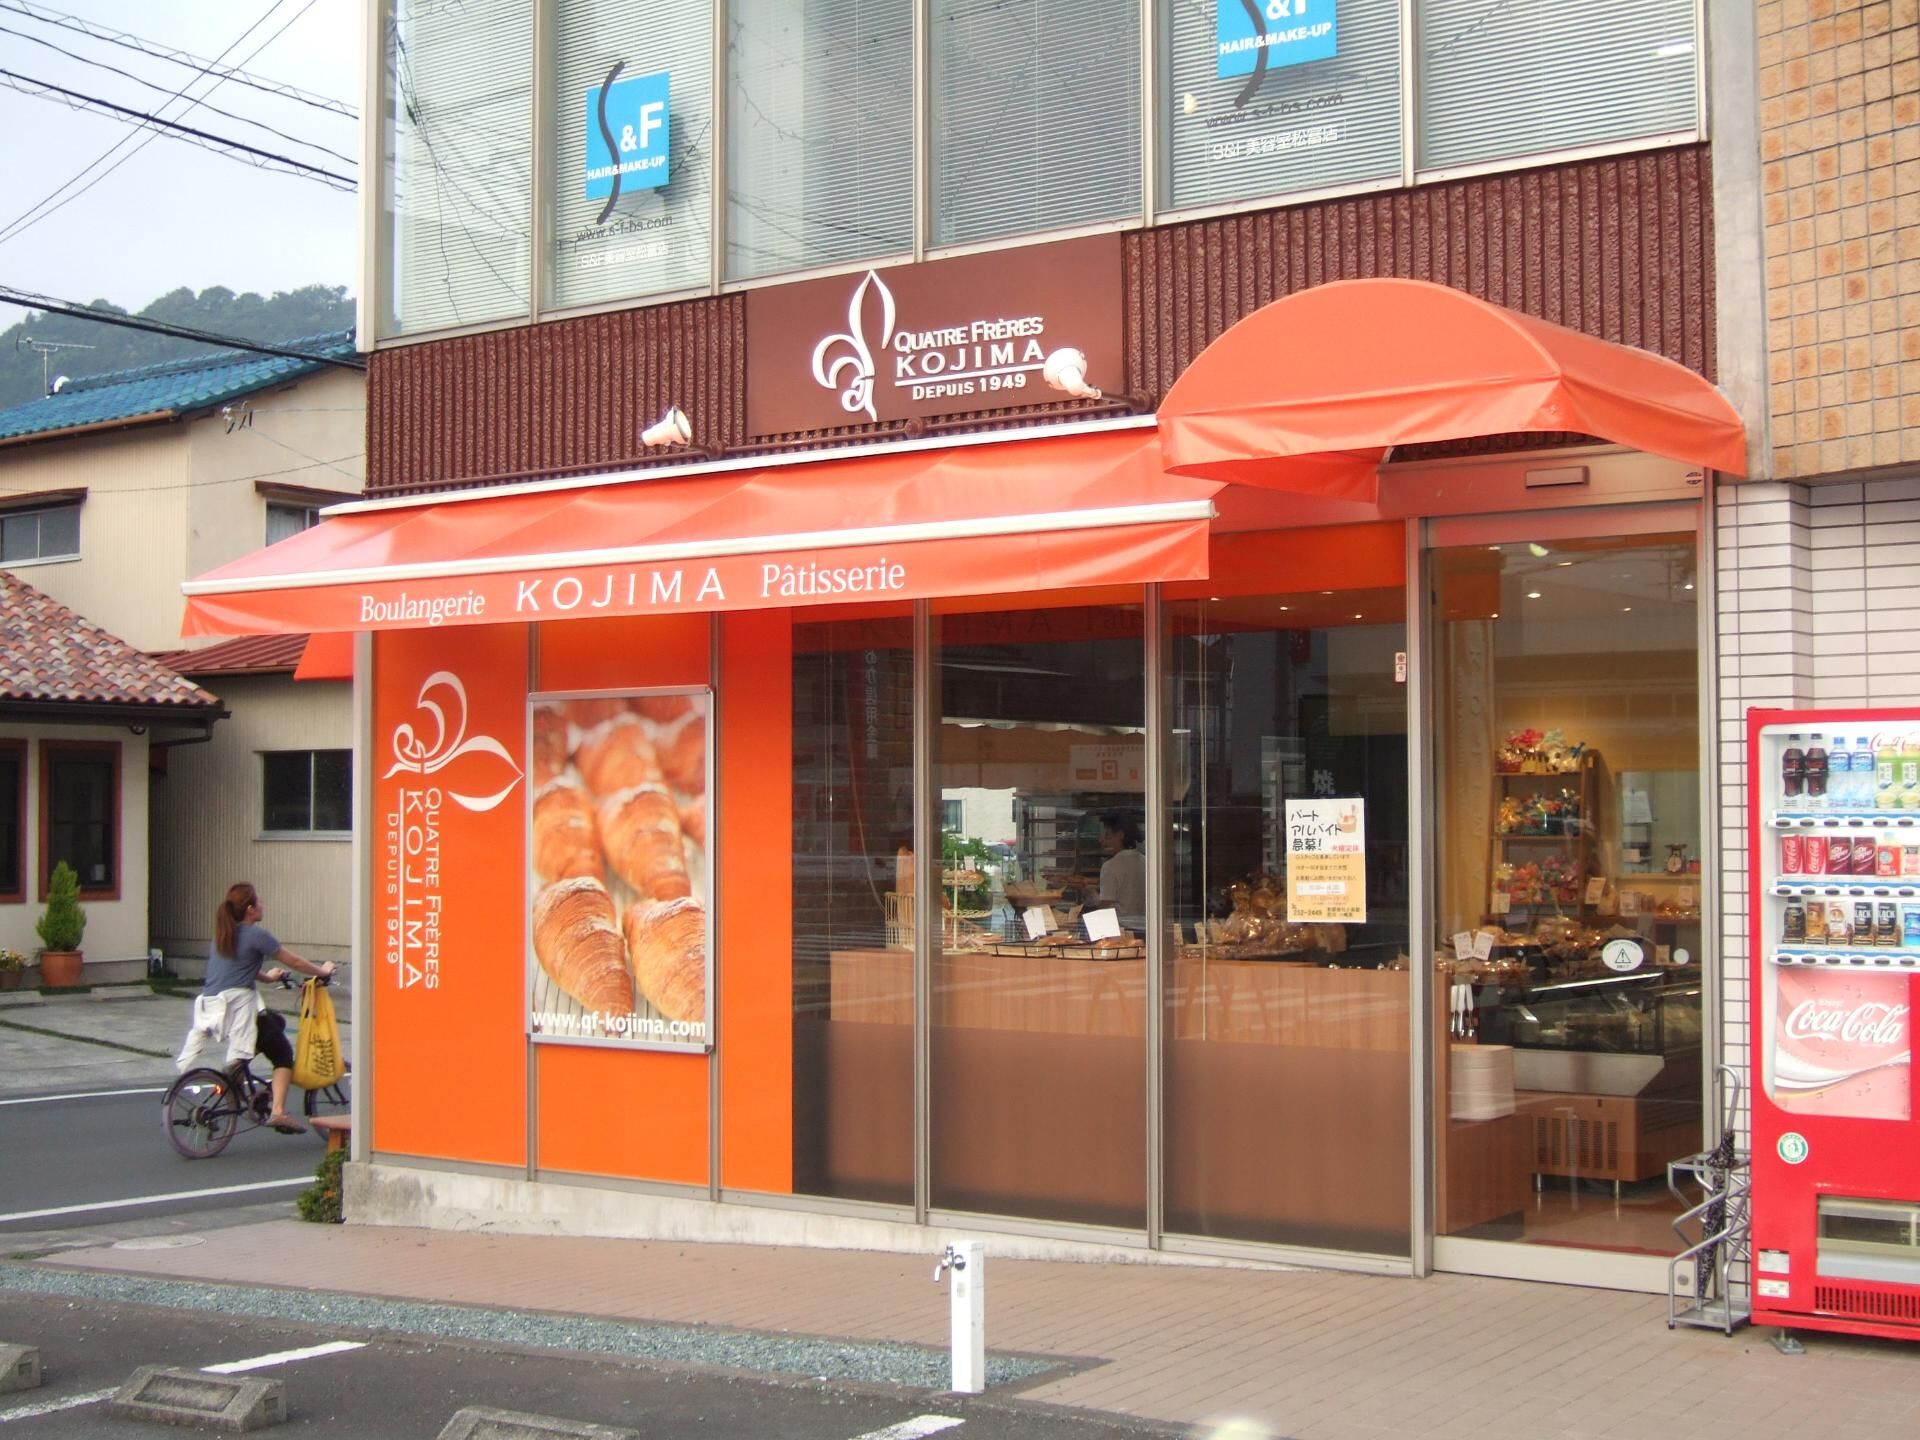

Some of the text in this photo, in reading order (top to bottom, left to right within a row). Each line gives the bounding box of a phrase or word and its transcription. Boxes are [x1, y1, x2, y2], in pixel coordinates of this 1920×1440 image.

[1220, 22, 1332, 54] HAIR&MAKE-UP
[587, 155, 666, 180] HAIR&MAKE-UP
[894, 316, 1044, 354] QUATRE FRÈRES
[896, 339, 1046, 379] KOJIMA
[912, 372, 1027, 401] DEPUIS 1949
[360, 557, 906, 626] Boulangerie KOJIMA Pâtisserie
[1290, 823, 1343, 837] アルバイト
[386, 813, 400, 965] DEPUIS 1949
[405, 790, 424, 989] KOJIMA
[425, 787, 443, 990] QUATRE FRÈRES
[532, 1011, 706, 1037] www.qf-kojima.com
[1785, 1000, 1911, 1045] Coca-Cola
